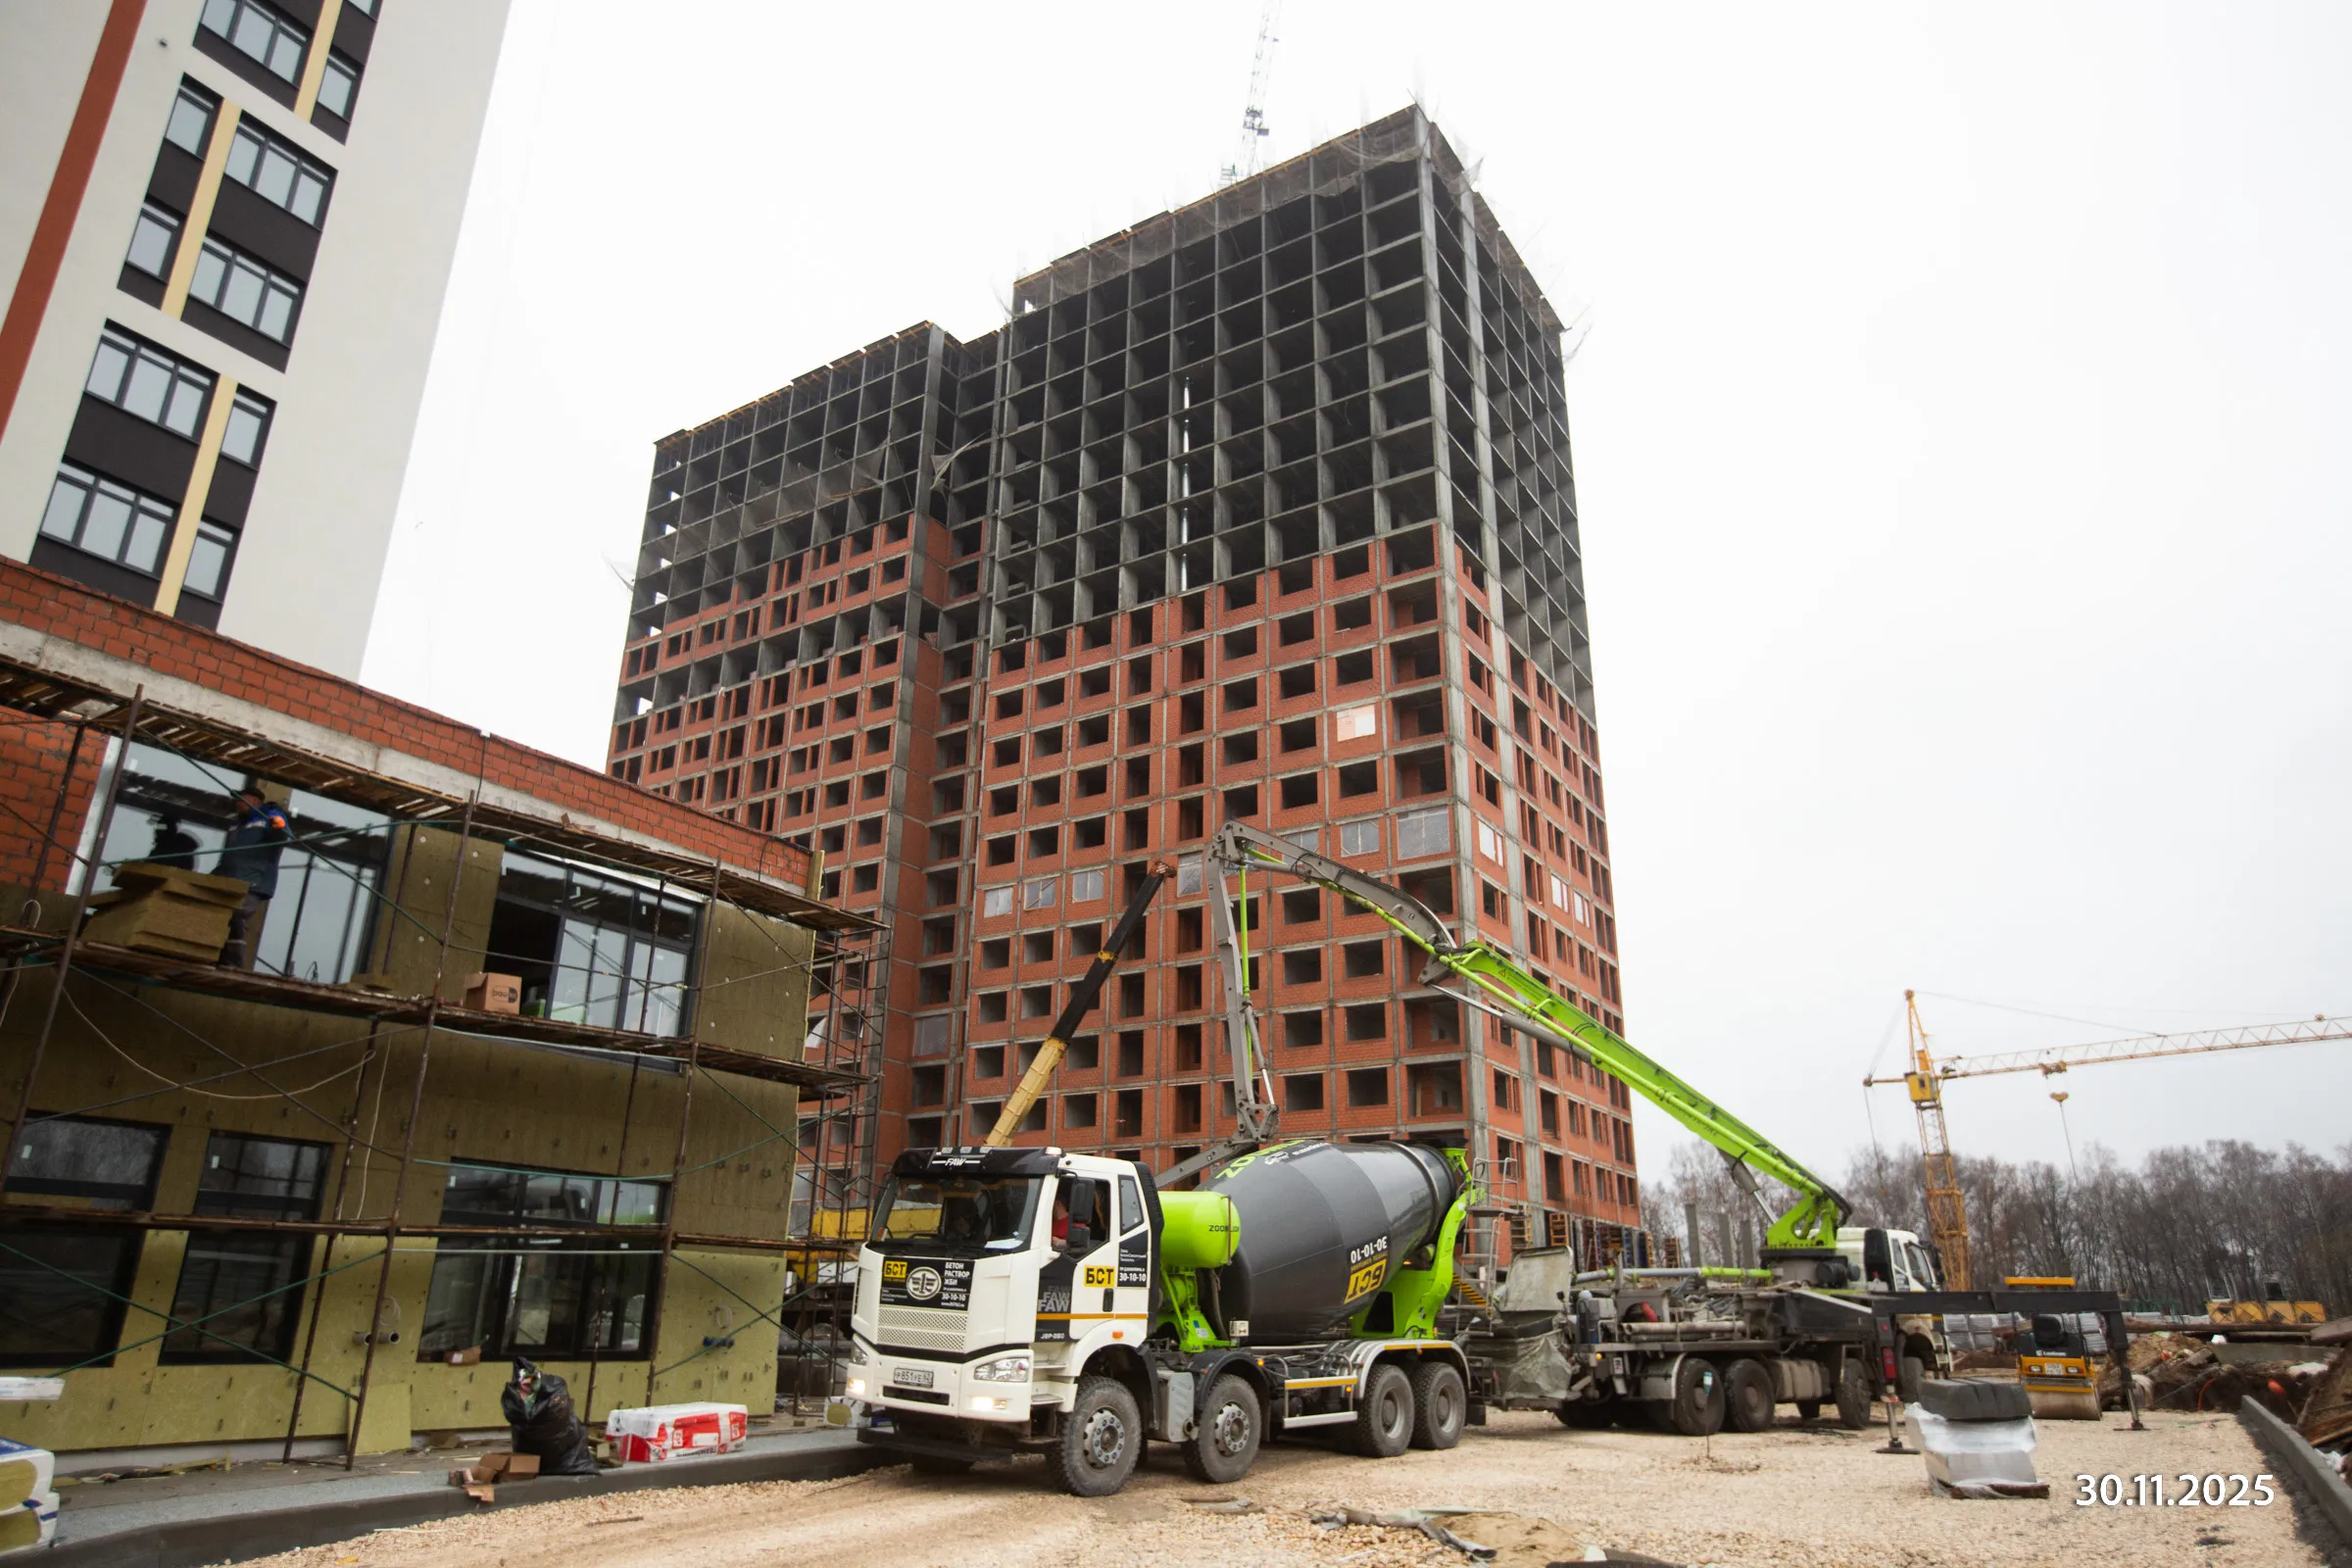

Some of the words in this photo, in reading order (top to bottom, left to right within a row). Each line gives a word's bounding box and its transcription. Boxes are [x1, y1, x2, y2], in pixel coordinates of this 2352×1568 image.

[1350, 1236, 1388, 1264] 30-10-10
[886, 1263, 906, 1275] БСТ
[945, 1261, 964, 1270] БЕТОН
[944, 1269, 970, 1278] РАСТВОР
[1086, 1267, 1114, 1284] БСТ
[1118, 1272, 1147, 1283] 30-10-10
[1347, 1263, 1384, 1300] БСТ
[941, 1293, 966, 1301] 30-10-10
[1038, 1299, 1070, 1312] FAW
